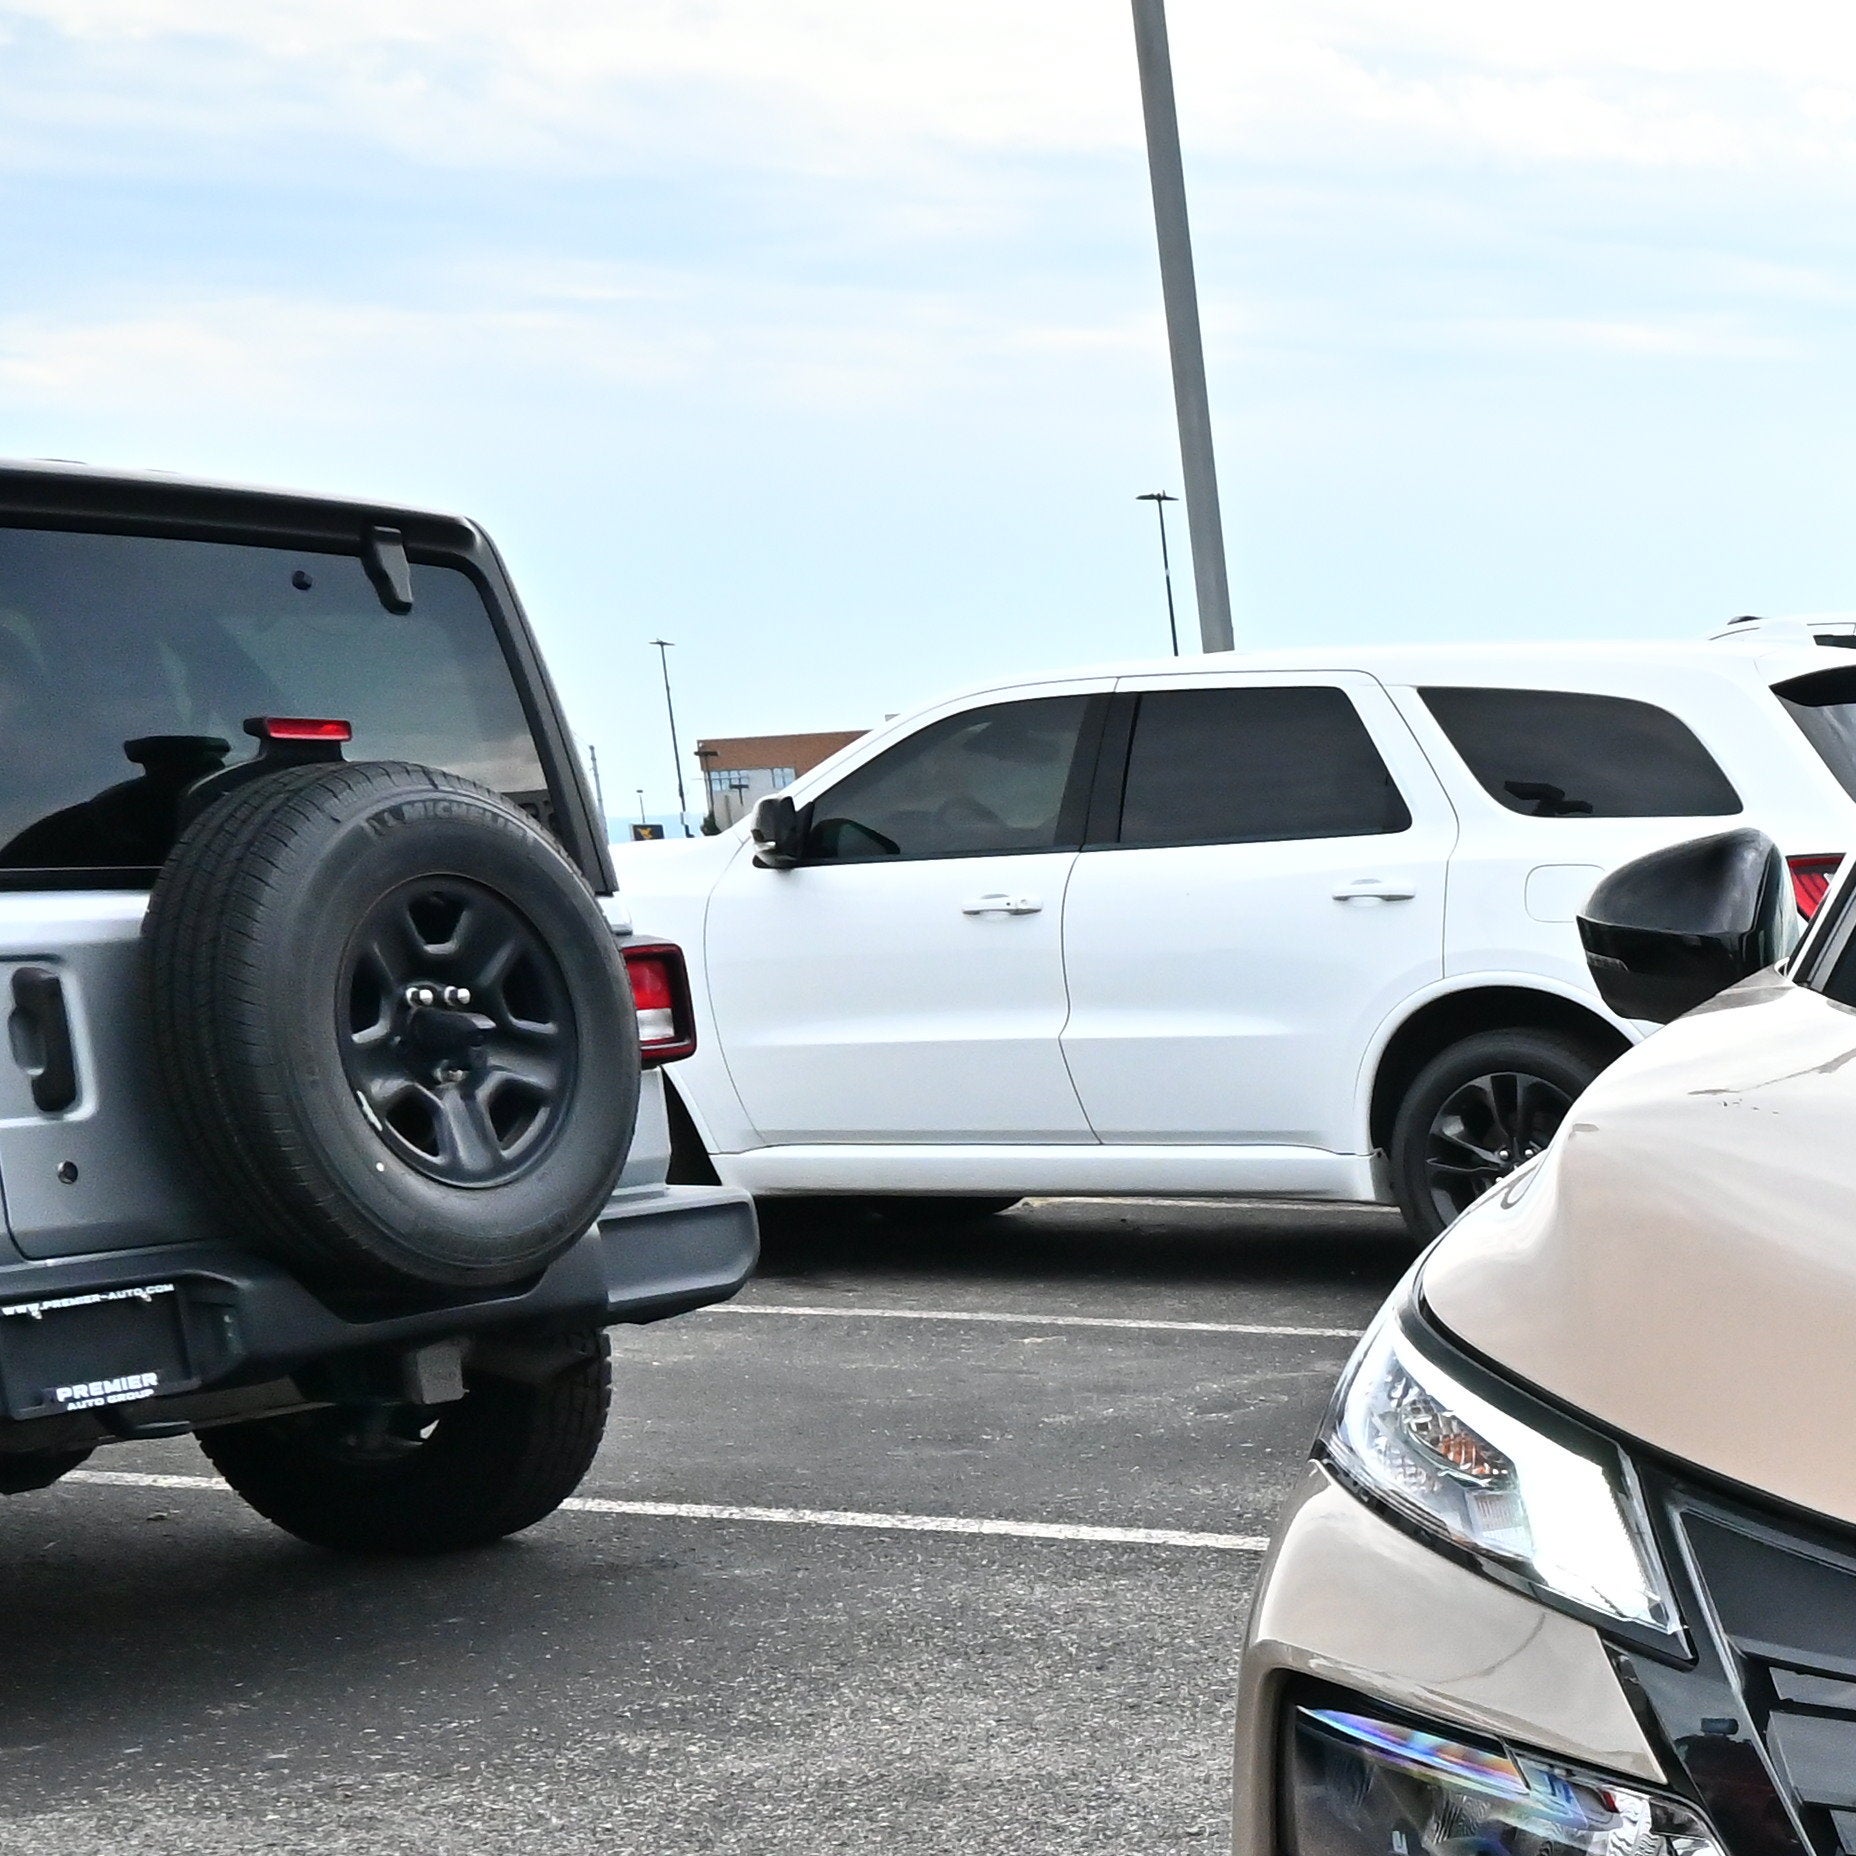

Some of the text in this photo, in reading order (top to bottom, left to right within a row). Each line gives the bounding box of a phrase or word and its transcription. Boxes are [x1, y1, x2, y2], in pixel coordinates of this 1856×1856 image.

[56, 1373, 158, 1402] PREMIER
[66, 1388, 155, 1411] AUTO GROUP
